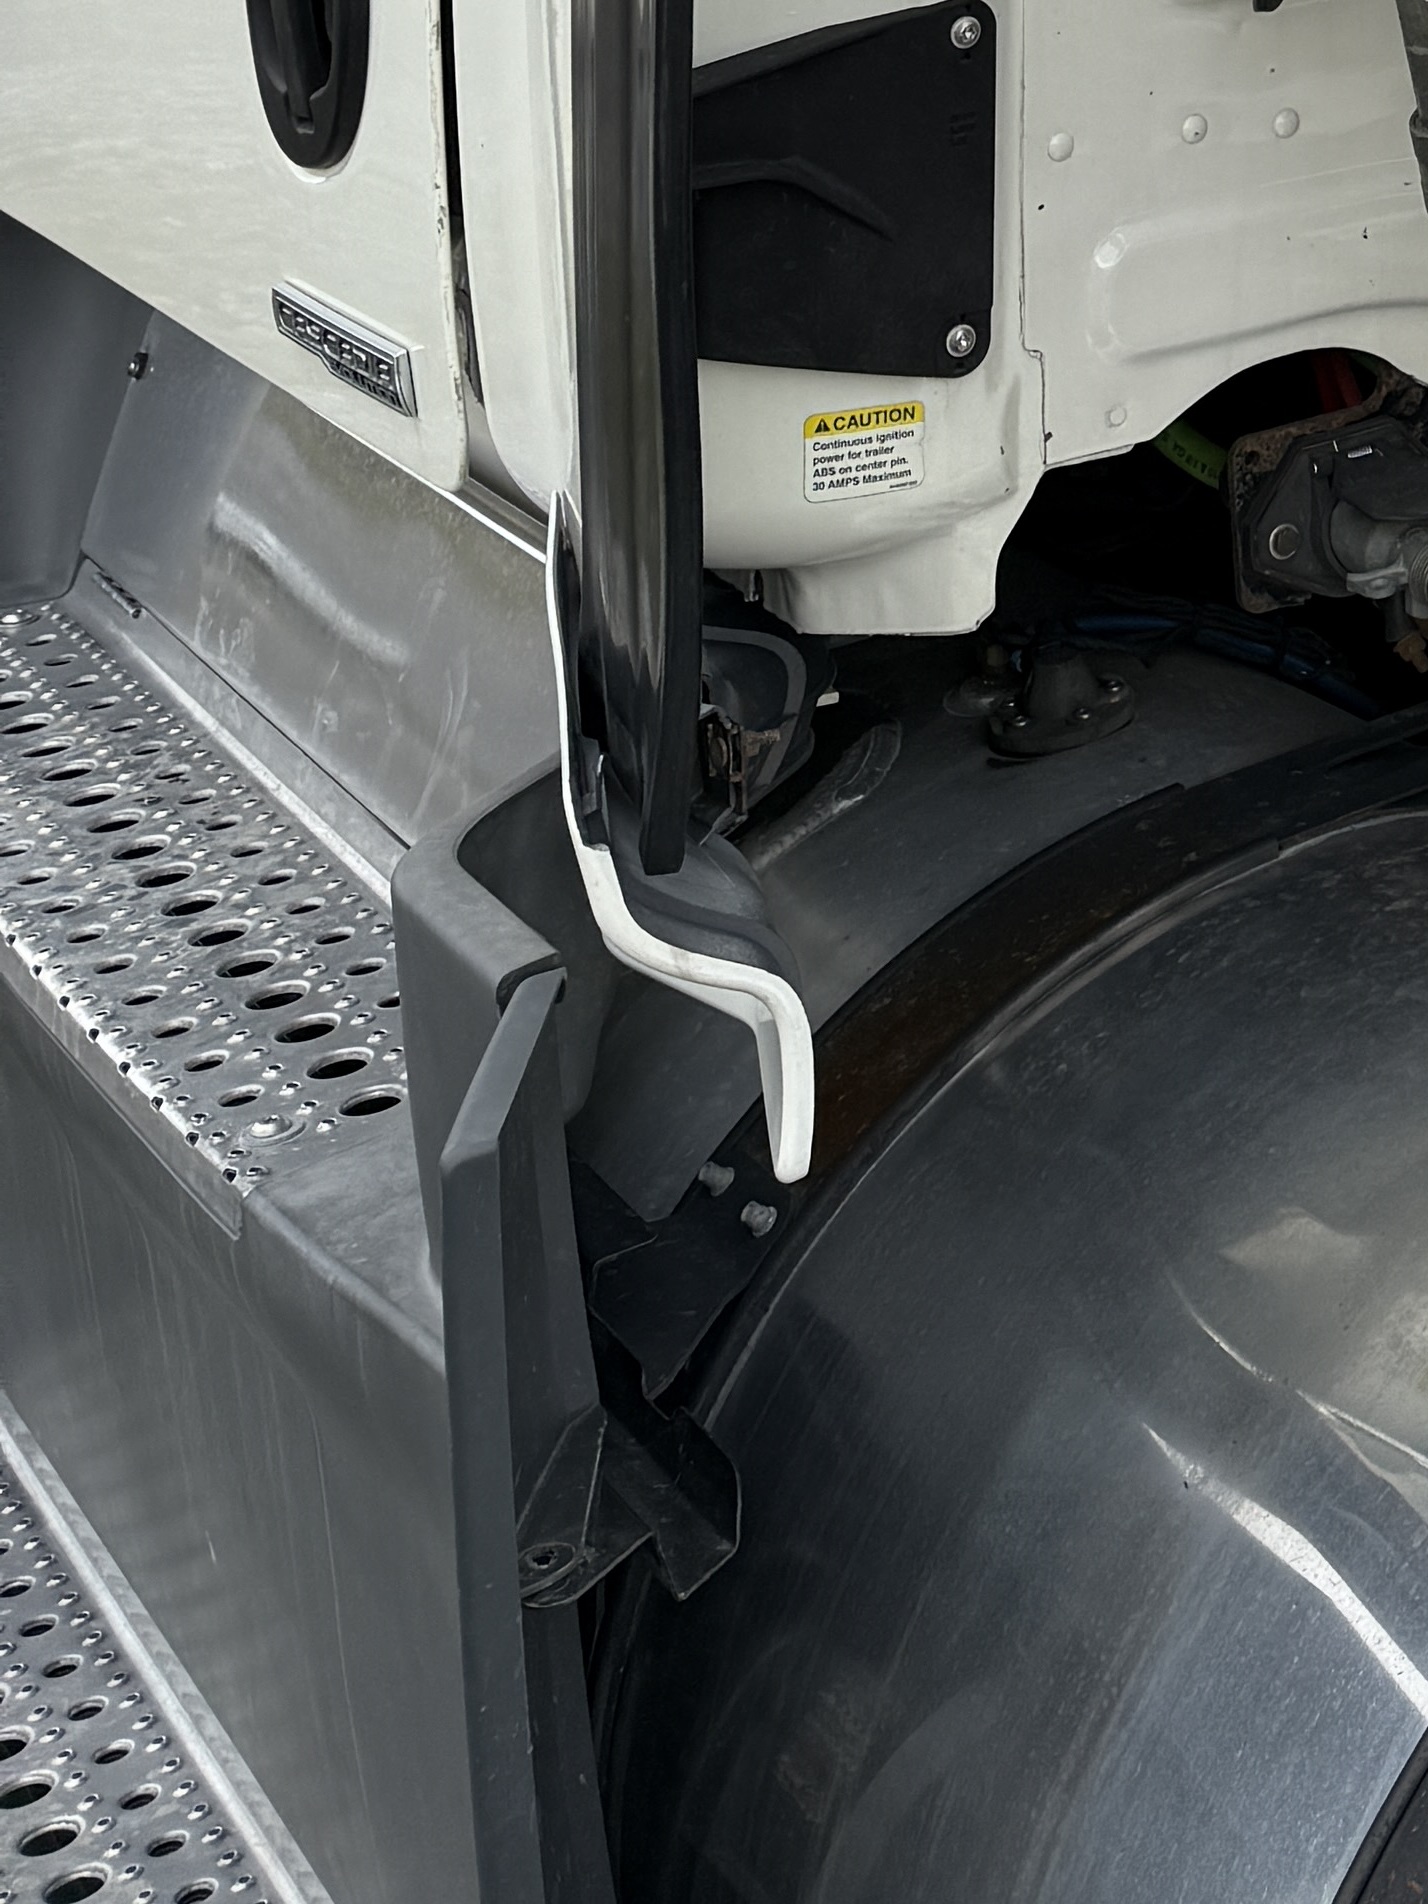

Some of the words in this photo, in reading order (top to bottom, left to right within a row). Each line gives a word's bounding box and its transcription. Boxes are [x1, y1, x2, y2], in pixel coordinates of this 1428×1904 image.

[834, 405, 915, 431] CAUTION
[813, 437, 873, 452] Continuous
[813, 454, 844, 467] power
[847, 451, 862, 460] for
[864, 446, 895, 458] trailer
[813, 467, 836, 478] ABS
[839, 467, 852, 475] on
[855, 460, 888, 472] center
[812, 481, 825, 491] 30
[828, 476, 860, 489] AMPS
[862, 469, 911, 484] Maximum
